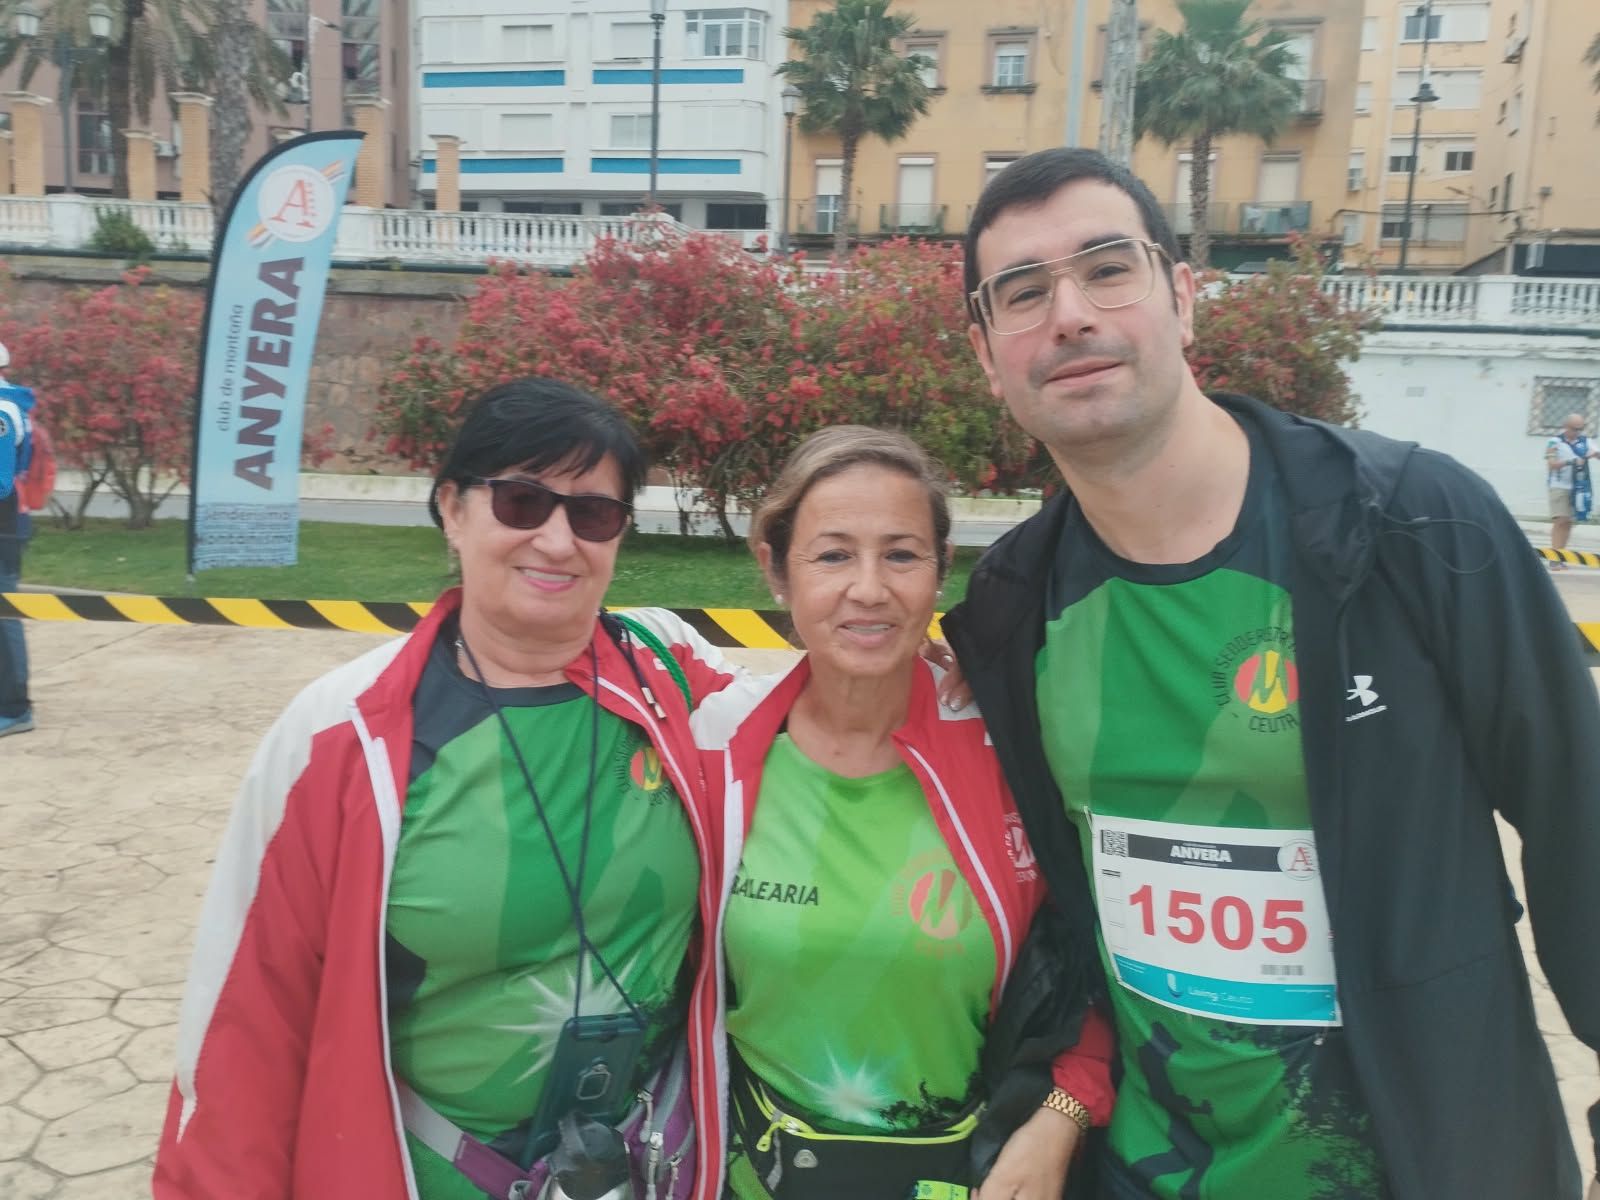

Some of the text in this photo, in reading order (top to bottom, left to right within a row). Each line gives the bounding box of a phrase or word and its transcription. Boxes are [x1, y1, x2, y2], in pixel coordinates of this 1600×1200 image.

[219, 377, 234, 397] de
[233, 256, 305, 491] ANYERA
[216, 401, 231, 432] club
[1169, 845, 1233, 863] ANYERA
[1128, 883, 1308, 954] 1505
